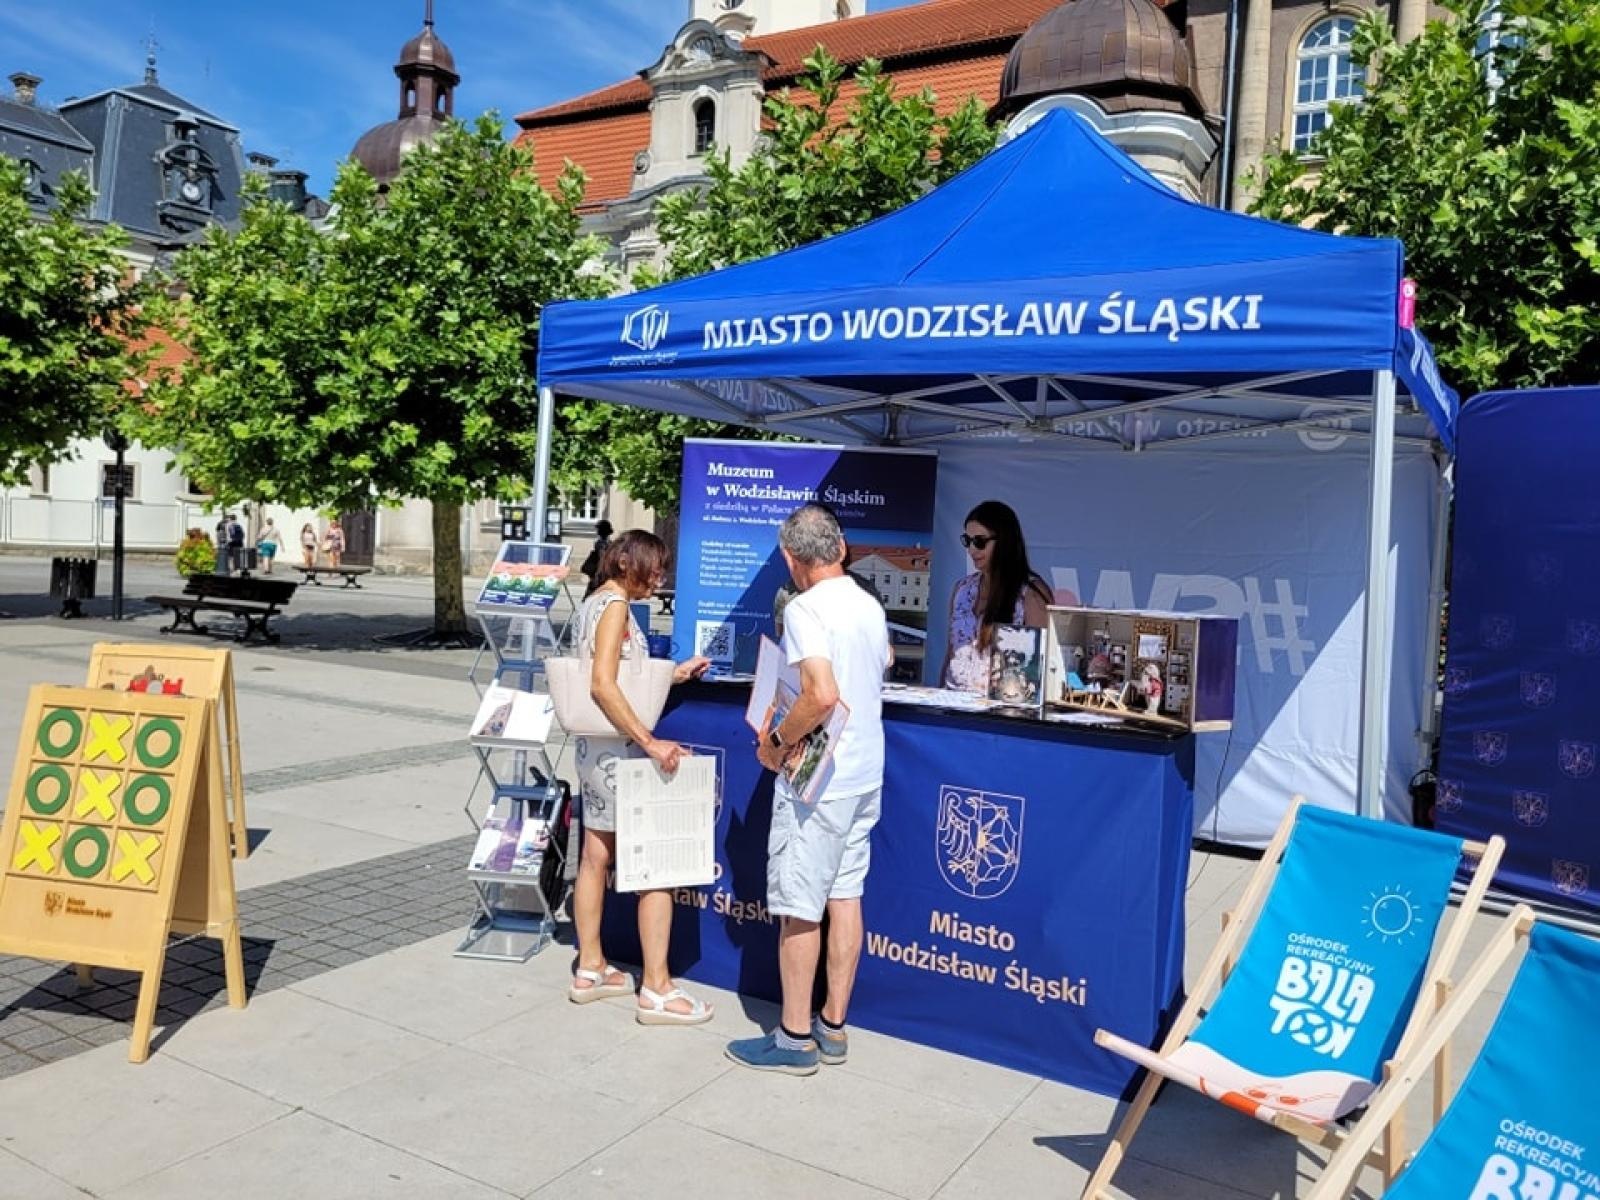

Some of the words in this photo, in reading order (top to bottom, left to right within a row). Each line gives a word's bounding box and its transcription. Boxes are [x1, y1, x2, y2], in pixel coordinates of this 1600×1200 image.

[703, 312, 833, 350] MIASTO
[842, 301, 1088, 341] WODZISŁAW
[1098, 291, 1264, 342] ŚLĄSKI
[707, 462, 774, 479] Muzeum
[706, 486, 720, 496] w
[723, 482, 818, 501] Wodzisławiu
[823, 485, 886, 506] Śląskim
[929, 910, 1015, 952] Miasto
[1287, 932, 1350, 955] OŚRODEK
[867, 931, 997, 985] Wodzisław
[1004, 959, 1087, 1006] Śląski
[1286, 944, 1376, 975] REKREACYJNY
[1499, 1118, 1586, 1160] OŚRODEK
